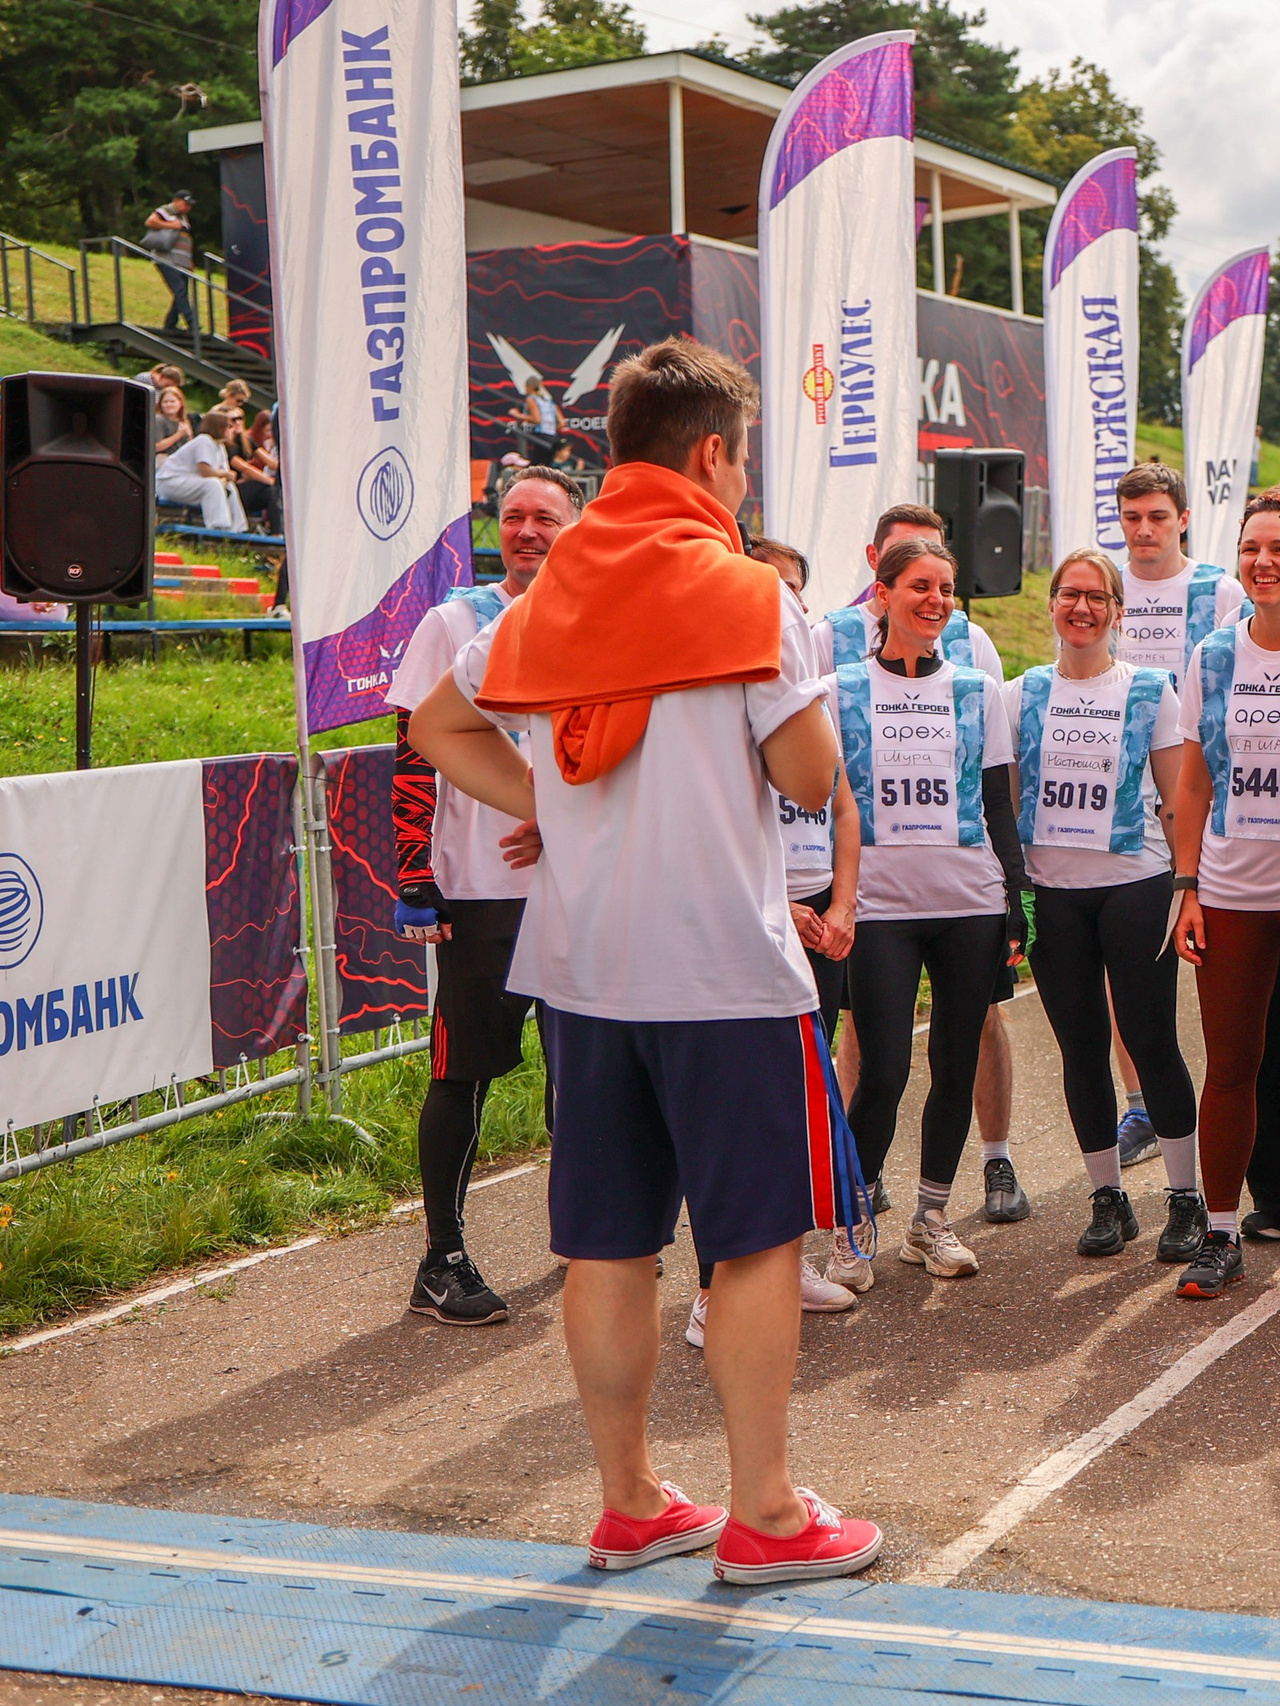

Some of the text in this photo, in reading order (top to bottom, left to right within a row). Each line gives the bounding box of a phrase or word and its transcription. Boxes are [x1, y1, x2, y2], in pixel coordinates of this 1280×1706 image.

[341, 25, 406, 422] ГАЗПРОМБАНК
[1081, 295, 1128, 550] СЕНЕЖСКАЯ
[1150, 606, 1183, 615] ГЕРОЕВ
[1125, 627, 1176, 642] apex
[347, 671, 389, 693] ГОНКА
[1233, 683, 1266, 693] ГОНКА
[875, 703, 950, 713] ГОНКА ГЕРОЕВ
[1050, 706, 1120, 718] ГОНКА ГЕРОЕВ
[882, 725, 945, 742] apex
[1052, 728, 1111, 745] apex
[881, 779, 949, 806] 5185
[1042, 780, 1108, 811] 5019
[1057, 826, 1095, 835] ГАЗПРОМБАНК
[0, 972, 144, 1056] ОМБАНК
